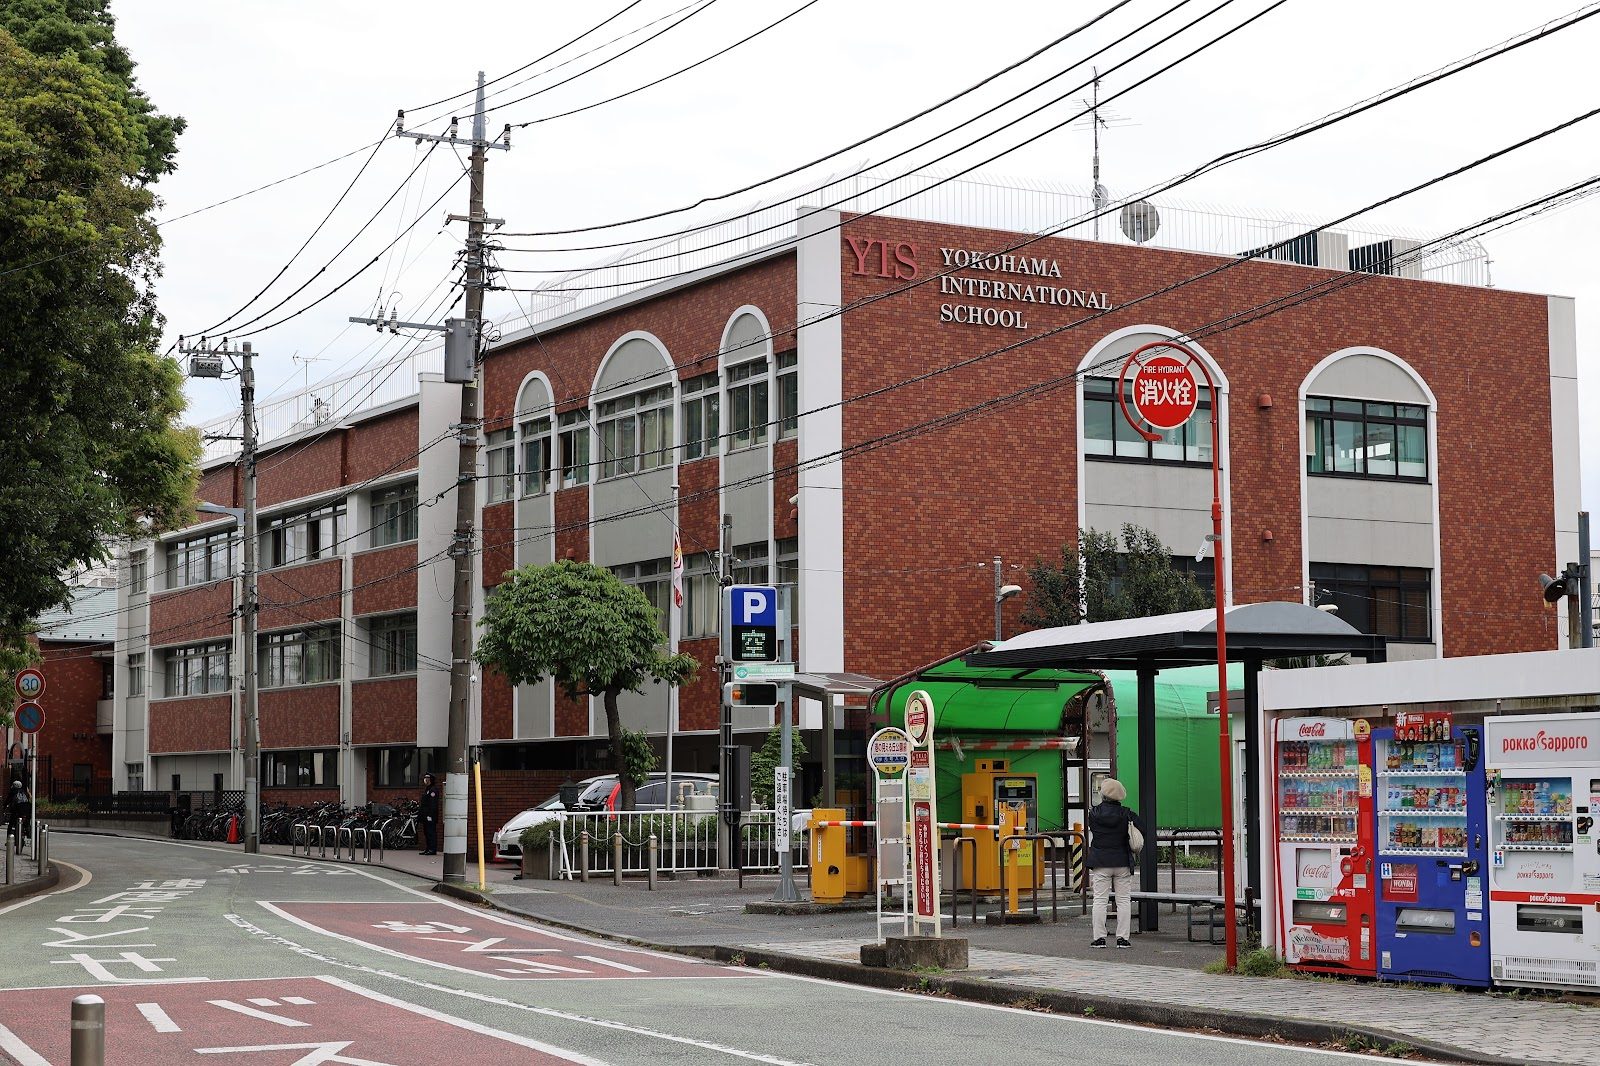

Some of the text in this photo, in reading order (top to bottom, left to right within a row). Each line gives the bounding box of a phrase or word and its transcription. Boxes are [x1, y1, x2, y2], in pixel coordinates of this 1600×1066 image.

[845, 236, 919, 281] YIS
[940, 247, 1062, 278] YOKOHAMA
[940, 276, 1113, 310] INTERNATIONAL
[940, 303, 1028, 330] SCHOOL
[1143, 366, 1185, 374] FIRE HYDRANT
[1138, 377, 1193, 407] 消火栓
[743, 591, 767, 623] P
[742, 629, 766, 658] 空
[22, 678, 38, 692] 30
[1393, 879, 1413, 888] WONDA
